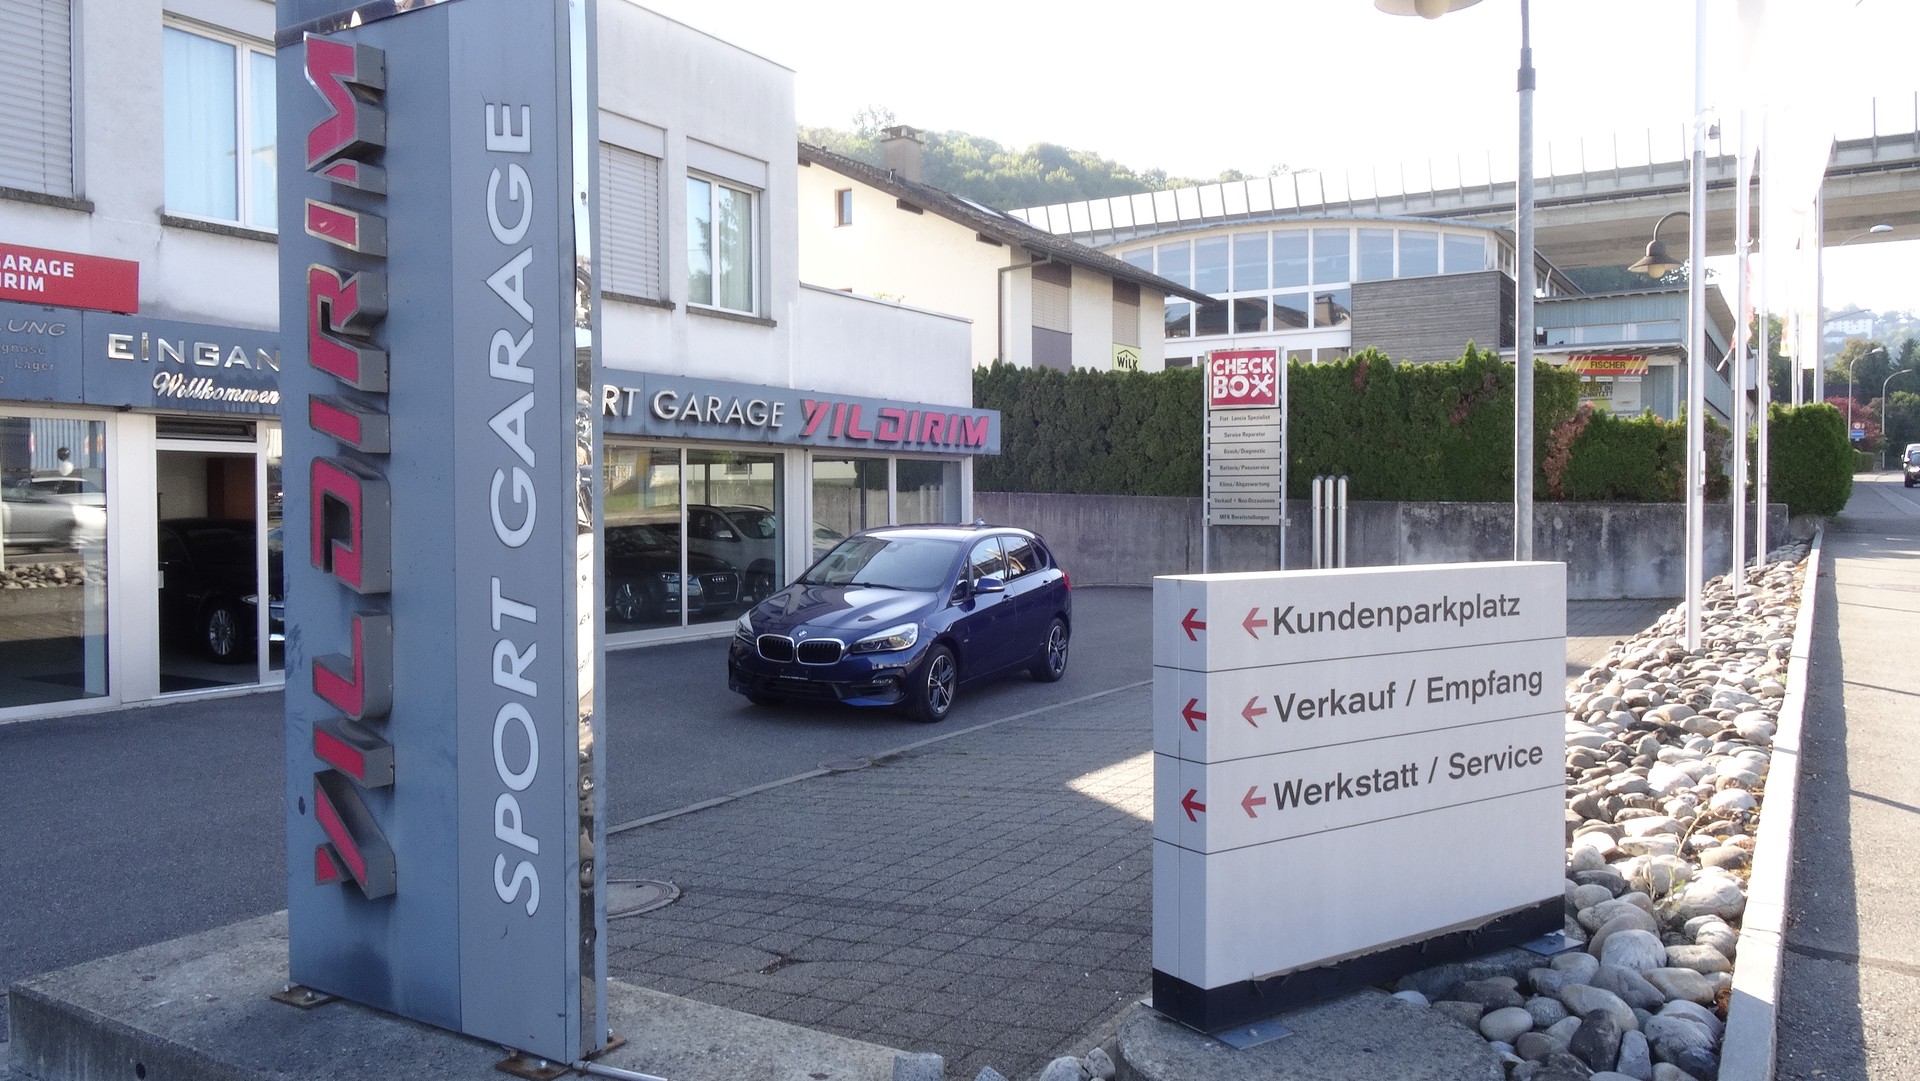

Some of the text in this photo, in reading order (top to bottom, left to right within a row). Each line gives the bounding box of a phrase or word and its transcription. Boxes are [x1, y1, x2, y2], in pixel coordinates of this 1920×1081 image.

[0, 253, 75, 279] ARAGE
[0, 271, 45, 293] RIM
[0, 318, 67, 336] UNG
[1212, 356, 1275, 376] CHECK
[1590, 361, 1626, 369] FISCHER
[152, 371, 281, 406] Willkommen
[1212, 373, 1275, 399] BOX
[602, 384, 989, 447] RT GARAGE YILDIRIM
[303, 31, 388, 900] YILDIRIM
[485, 102, 541, 918] SPORT GARAGE
[1272, 593, 1521, 636] Kundenparkplatz
[1273, 669, 1543, 723] Verkauf / Empfang
[1273, 744, 1544, 811] Werkstatt / Service
